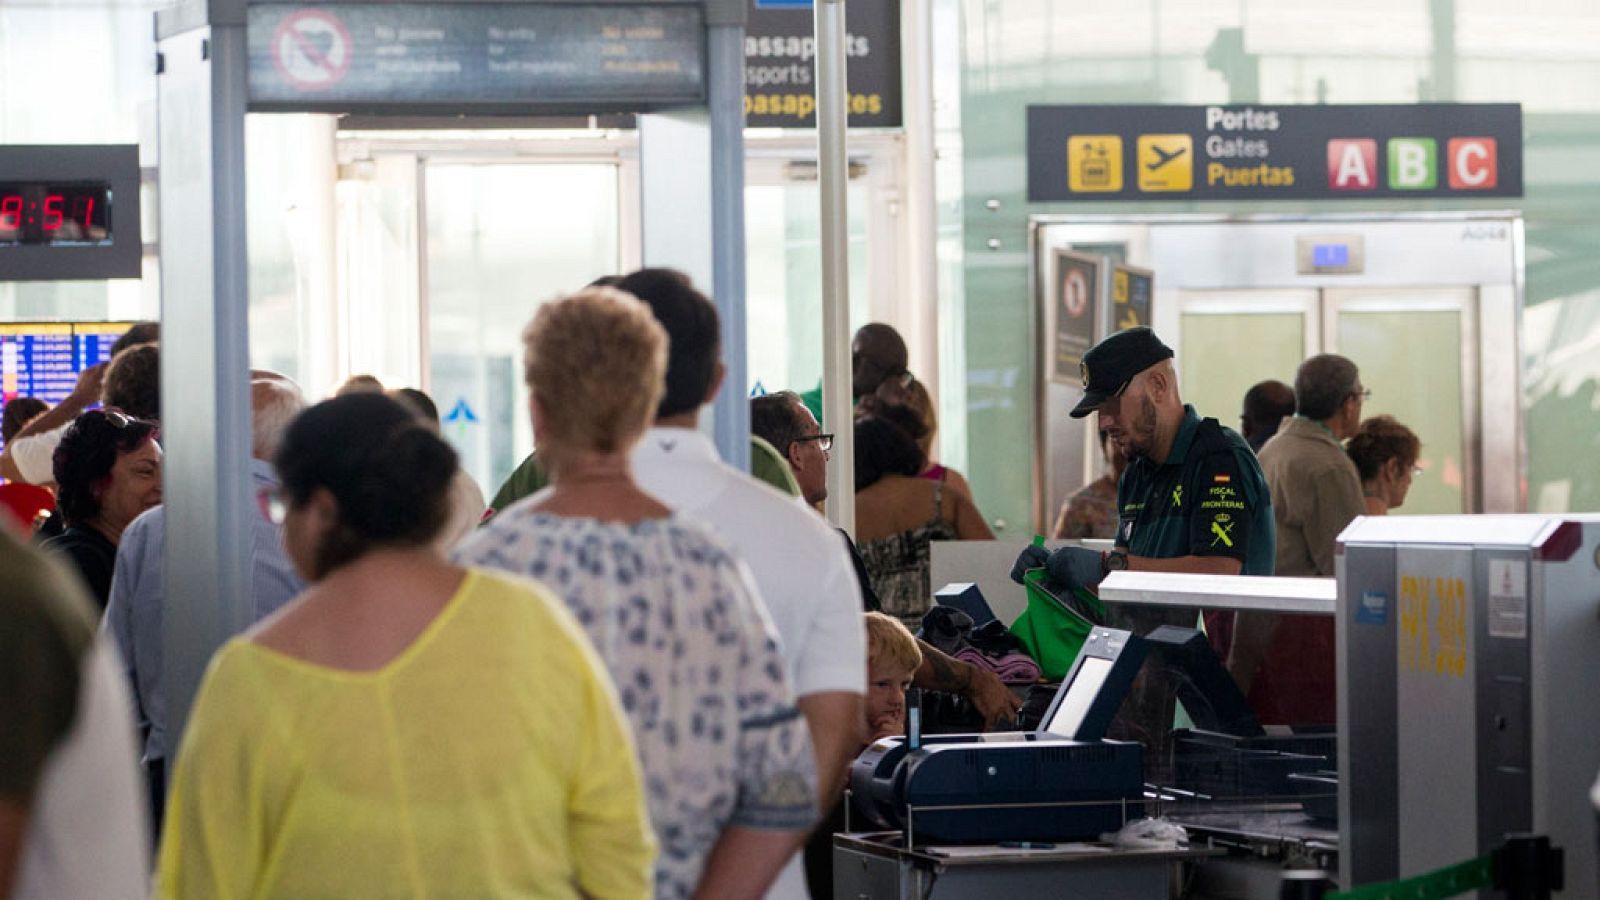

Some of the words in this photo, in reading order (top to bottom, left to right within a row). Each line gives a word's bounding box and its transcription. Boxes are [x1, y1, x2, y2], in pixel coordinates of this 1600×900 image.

[745, 33, 869, 61] assapts
[747, 63, 811, 87] sports
[1206, 107, 1279, 131] Portes
[1206, 135, 1268, 158] Gates
[1207, 163, 1294, 187] Puertas
[1335, 143, 1370, 187] A
[1396, 143, 1428, 186] B
[1455, 142, 1488, 186] C
[1209, 487, 1236, 496] FISCAL
